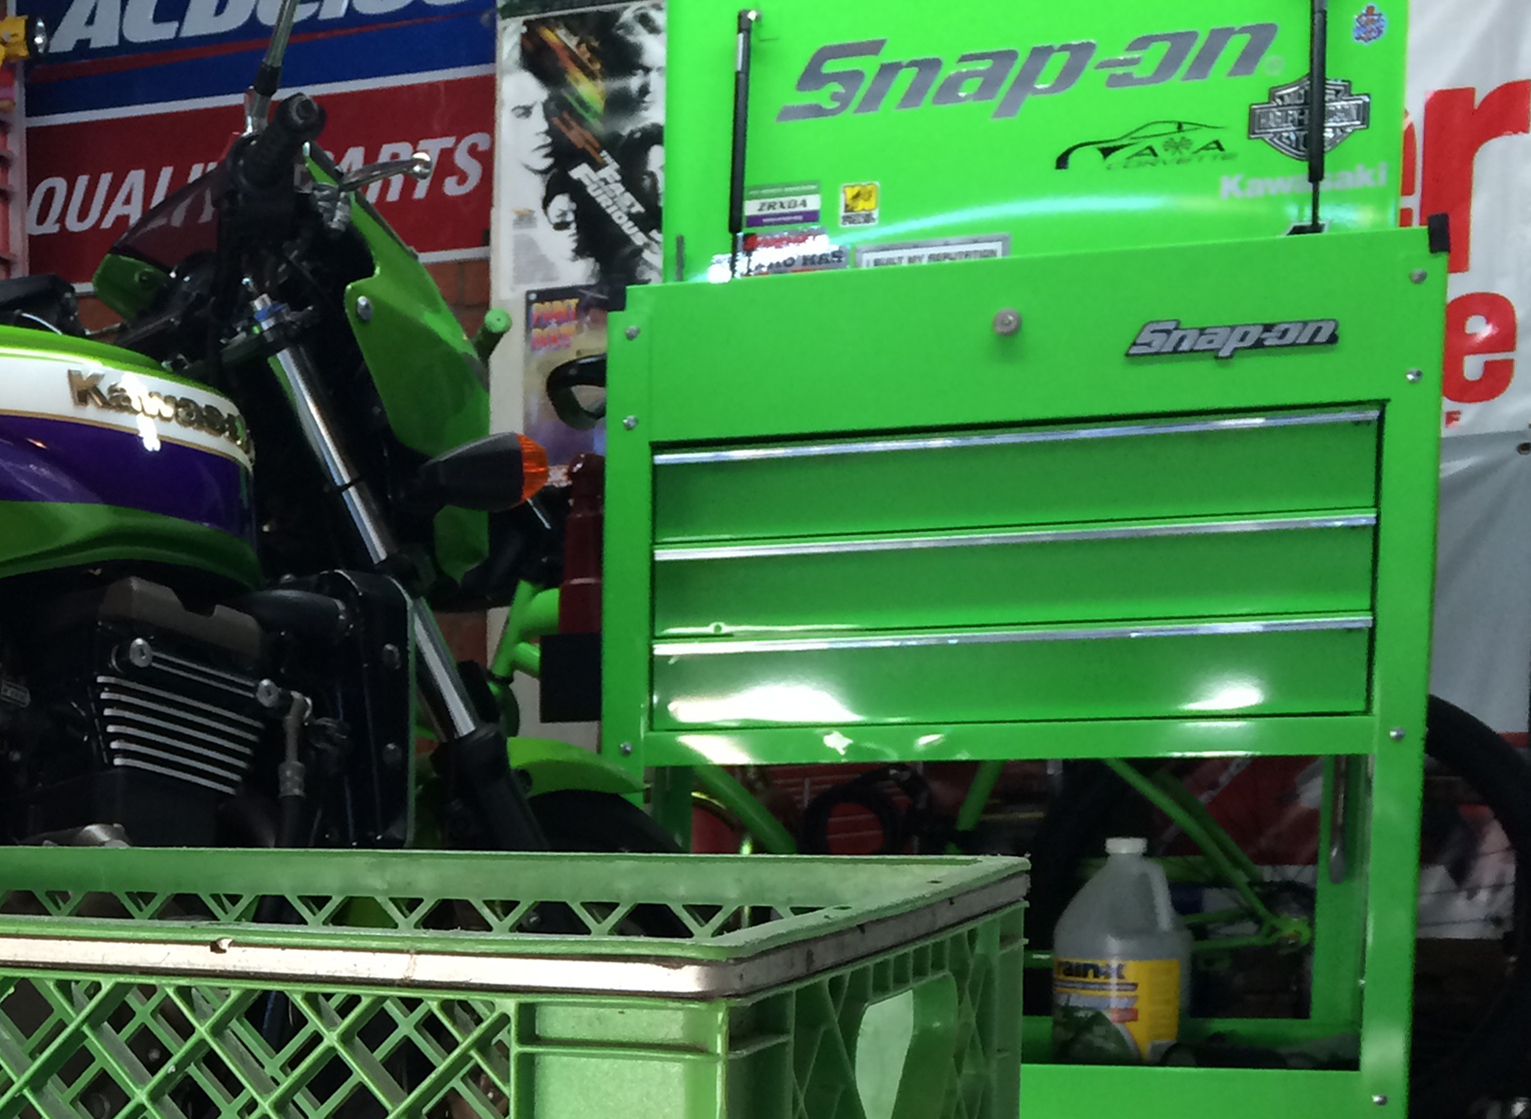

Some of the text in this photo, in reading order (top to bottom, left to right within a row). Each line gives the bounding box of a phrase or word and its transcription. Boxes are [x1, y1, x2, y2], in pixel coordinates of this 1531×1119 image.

[775, 22, 1279, 123] Snap-on
[294, 131, 492, 207] ARTS
[1126, 319, 1339, 360] Snap-on
